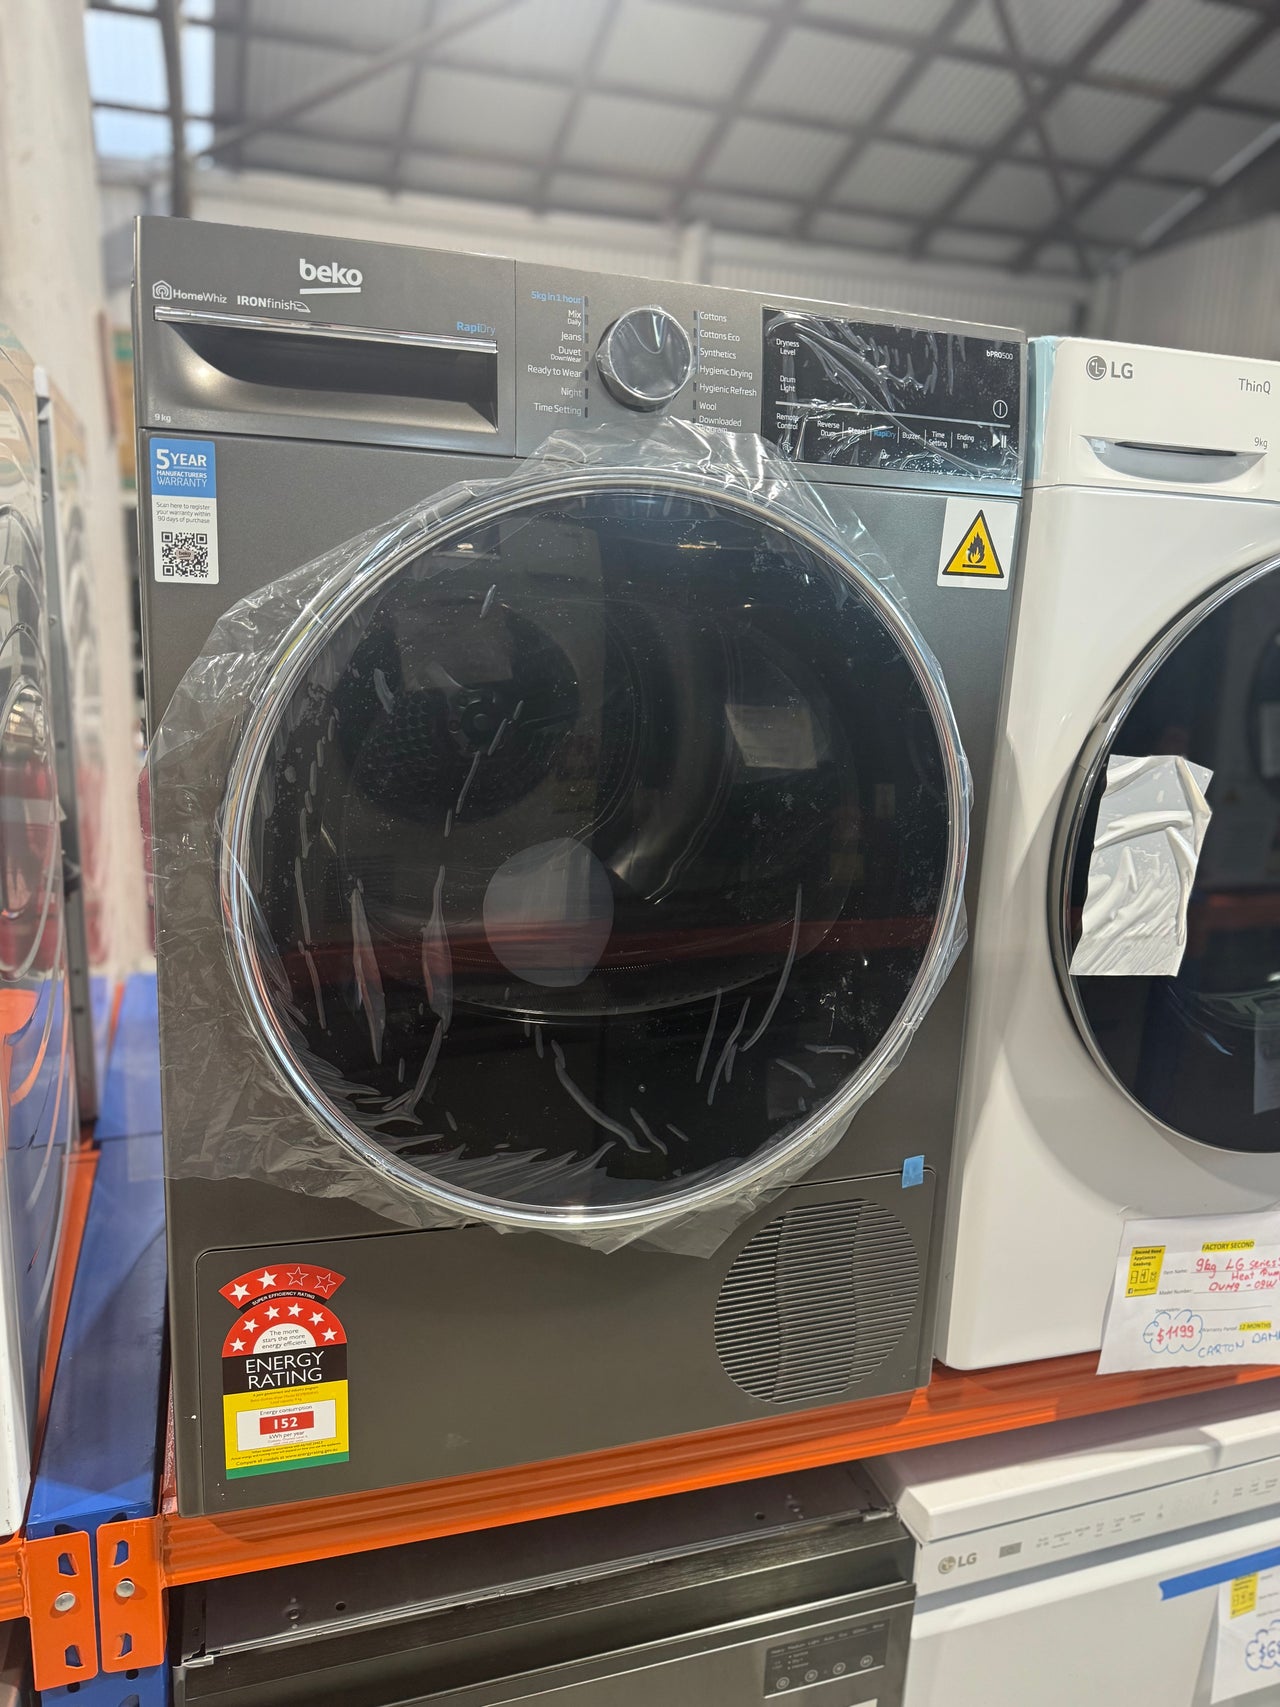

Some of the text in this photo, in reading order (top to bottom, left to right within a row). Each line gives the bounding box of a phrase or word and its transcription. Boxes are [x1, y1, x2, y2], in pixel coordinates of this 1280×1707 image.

[300, 258, 362, 286] beko
[173, 289, 228, 304] HomeWhiz
[532, 291, 546, 301] 5kg
[562, 294, 581, 304] hour
[237, 295, 296, 311] IRONfinish
[568, 310, 582, 319] Mix
[700, 312, 727, 322] Cottons
[568, 318, 582, 327] Daily
[456, 321, 496, 336] RapiDry
[561, 332, 582, 342] Jeans
[700, 330, 740, 342] Cottons Eco
[776, 338, 800, 348] Dryness
[558, 346, 582, 356] Duvet
[700, 348, 736, 360] Synthetics
[780, 347, 796, 356] Level
[986, 350, 1013, 360] bPRO500
[550, 354, 582, 363] DownWear
[528, 364, 582, 378] Ready to Wear
[700, 366, 752, 380] Hygienic Drying
[1111, 361, 1134, 380] LG
[780, 375, 796, 384] Drum
[700, 384, 756, 397] Hygienic Refresh
[780, 384, 795, 392] Light
[1238, 378, 1271, 395] ThinQ
[561, 388, 582, 398] Night
[534, 403, 582, 416] Time Setting
[700, 402, 716, 410] Wool
[700, 416, 742, 427] Downloaded
[776, 413, 799, 422] Remote
[777, 420, 798, 430] Control
[817, 420, 840, 430] Reverse
[874, 428, 896, 440] RapiDry
[902, 432, 920, 440] Buzzer
[932, 431, 945, 439] Time
[957, 434, 974, 443] Ending
[929, 439, 948, 448] Setting
[1254, 437, 1268, 450] 9kg
[156, 448, 207, 470] 5 YEAR
[156, 470, 208, 479] MANUFACTURERS
[156, 476, 208, 488] WARRANTY
[190, 504, 210, 512] register
[1202, 1240, 1255, 1252] FACTORY SECOND
[1196, 1258, 1216, 1278] 9kg
[1226, 1258, 1244, 1272] LG
[1232, 1270, 1254, 1281] Heat
[252, 1291, 316, 1306] SUPER EFFICIENCY RATING
[1248, 1322, 1272, 1330] MONTHS
[1156, 1324, 1195, 1345] $1199
[1198, 1340, 1244, 1358] CARTON
[246, 1350, 324, 1374] ENERGY
[248, 1368, 322, 1390] RATING
[279, 1404, 312, 1414] consumption
[274, 1417, 298, 1430] 152
[958, 1552, 978, 1568] LG
